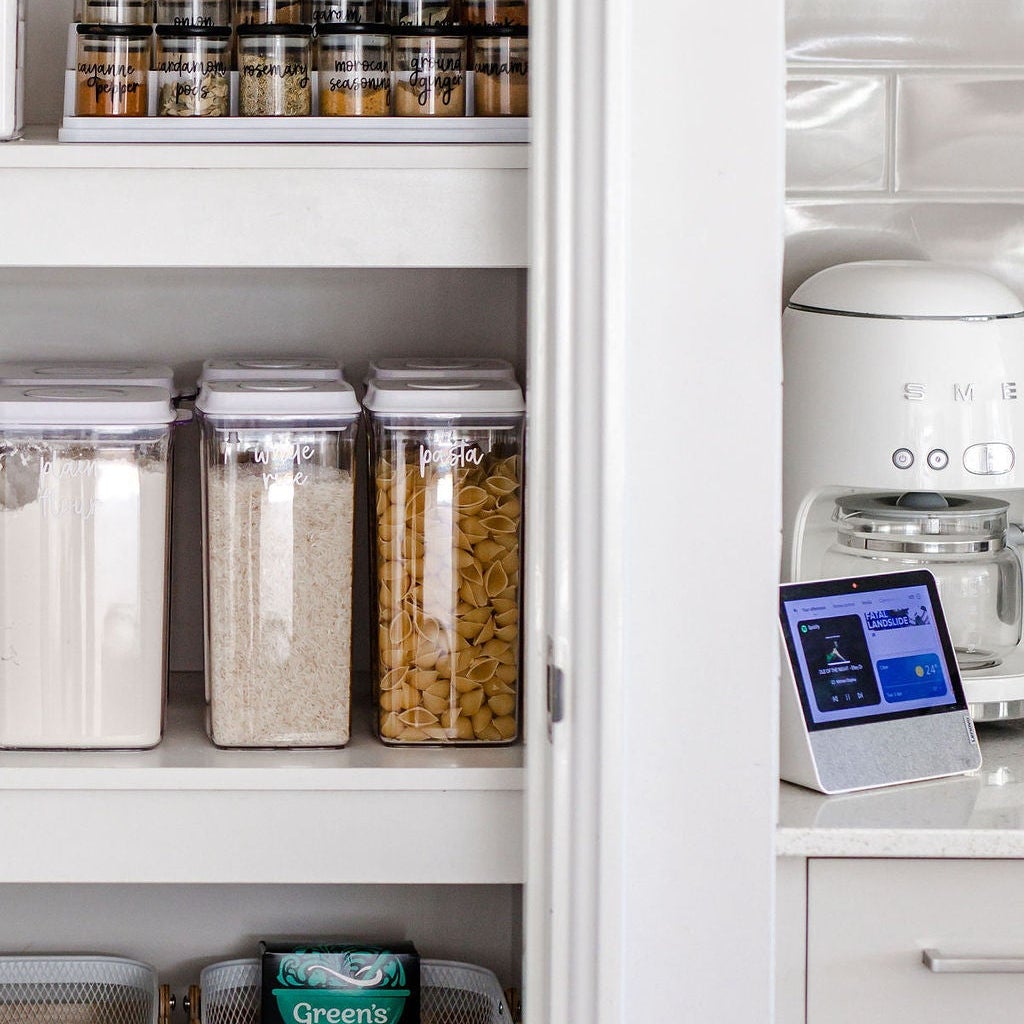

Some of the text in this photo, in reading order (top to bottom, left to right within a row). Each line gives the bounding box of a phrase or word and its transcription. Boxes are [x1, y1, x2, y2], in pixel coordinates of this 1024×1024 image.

[243, 62, 310, 88] rosemary
[409, 52, 462, 86] ground
[418, 74, 464, 106] ginger
[419, 439, 485, 478] pasta
[262, 471, 308, 490] re
[865, 610, 889, 621] FATAL
[866, 616, 909, 629] LANDSLIDE
[293, 1002, 388, 1024] Green's
